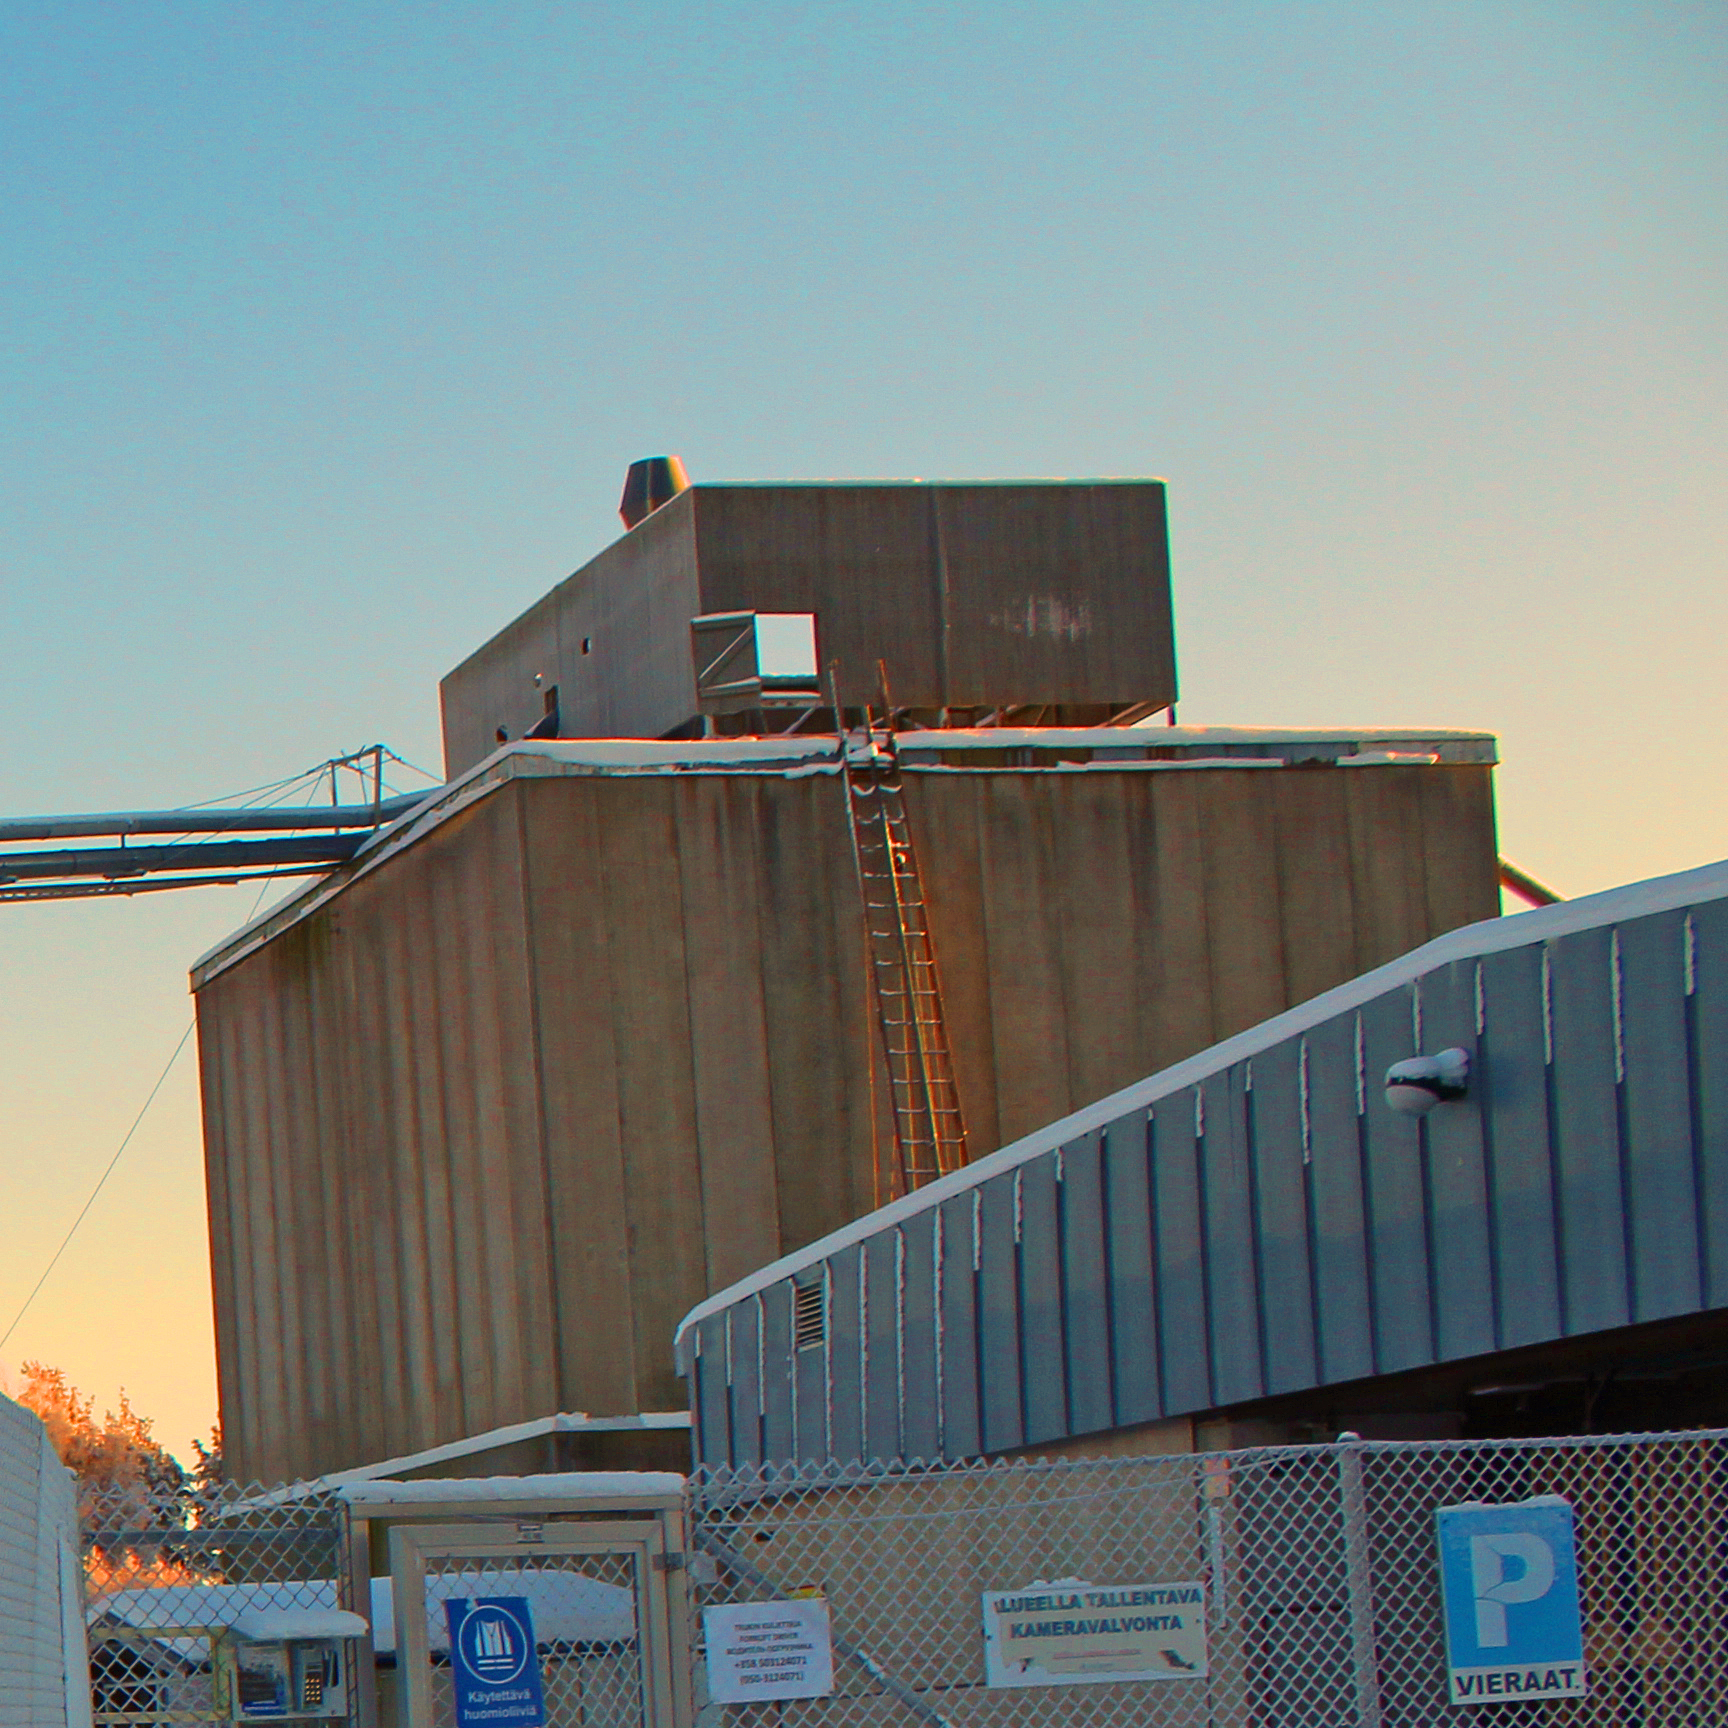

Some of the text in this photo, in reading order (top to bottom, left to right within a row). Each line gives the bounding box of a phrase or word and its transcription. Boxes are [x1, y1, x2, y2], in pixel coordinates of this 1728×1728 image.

[1084, 1588, 1202, 1608] TALLENTAVA
[1471, 1533, 1555, 1648] P
[1010, 1615, 1183, 1638] KAMERAVALVONTA
[468, 1688, 532, 1704] Käytettävä
